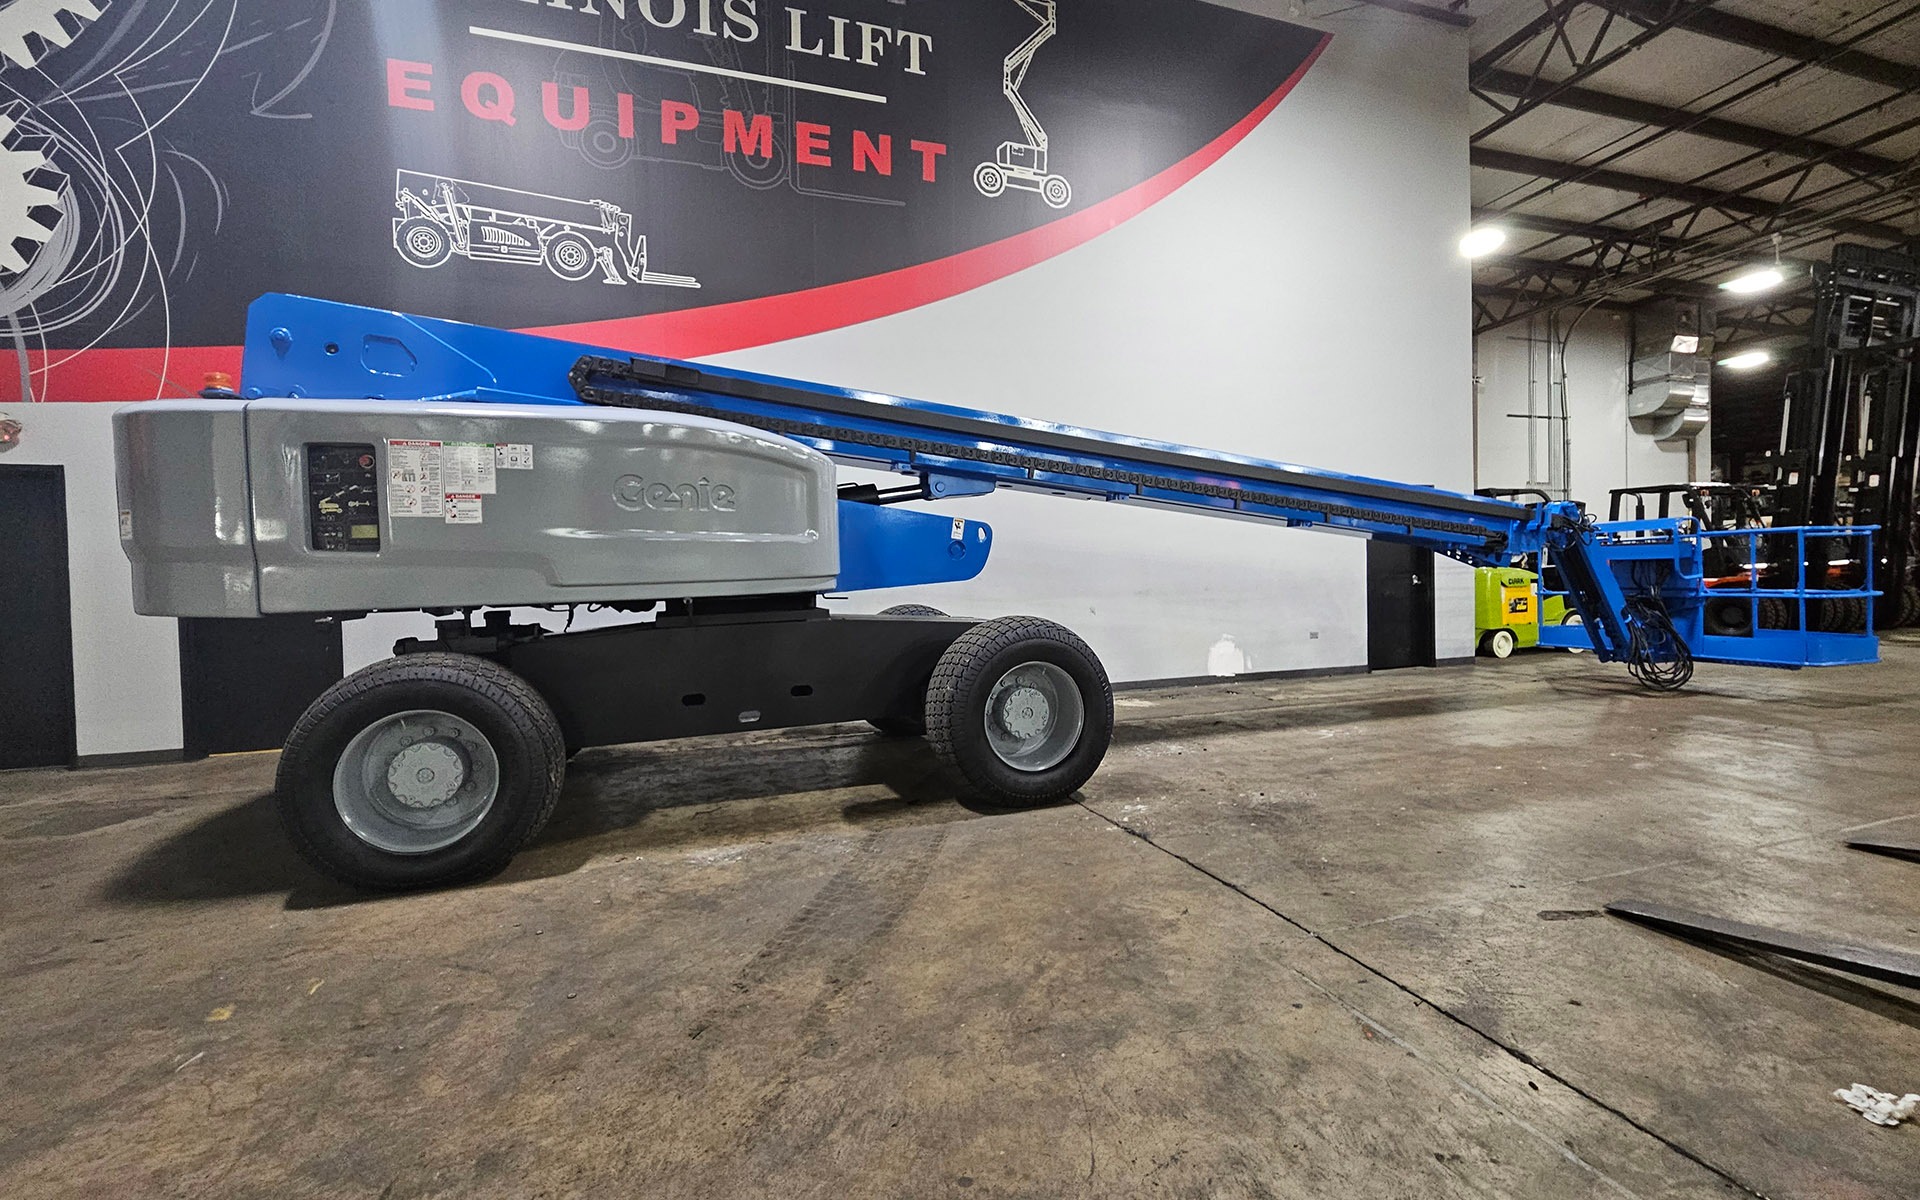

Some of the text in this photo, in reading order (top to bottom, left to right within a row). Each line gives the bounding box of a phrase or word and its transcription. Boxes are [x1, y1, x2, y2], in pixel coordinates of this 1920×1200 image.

[785, 7, 932, 75] LIFT
[386, 58, 947, 183] EQUIPMENT
[612, 473, 736, 512] Genie
